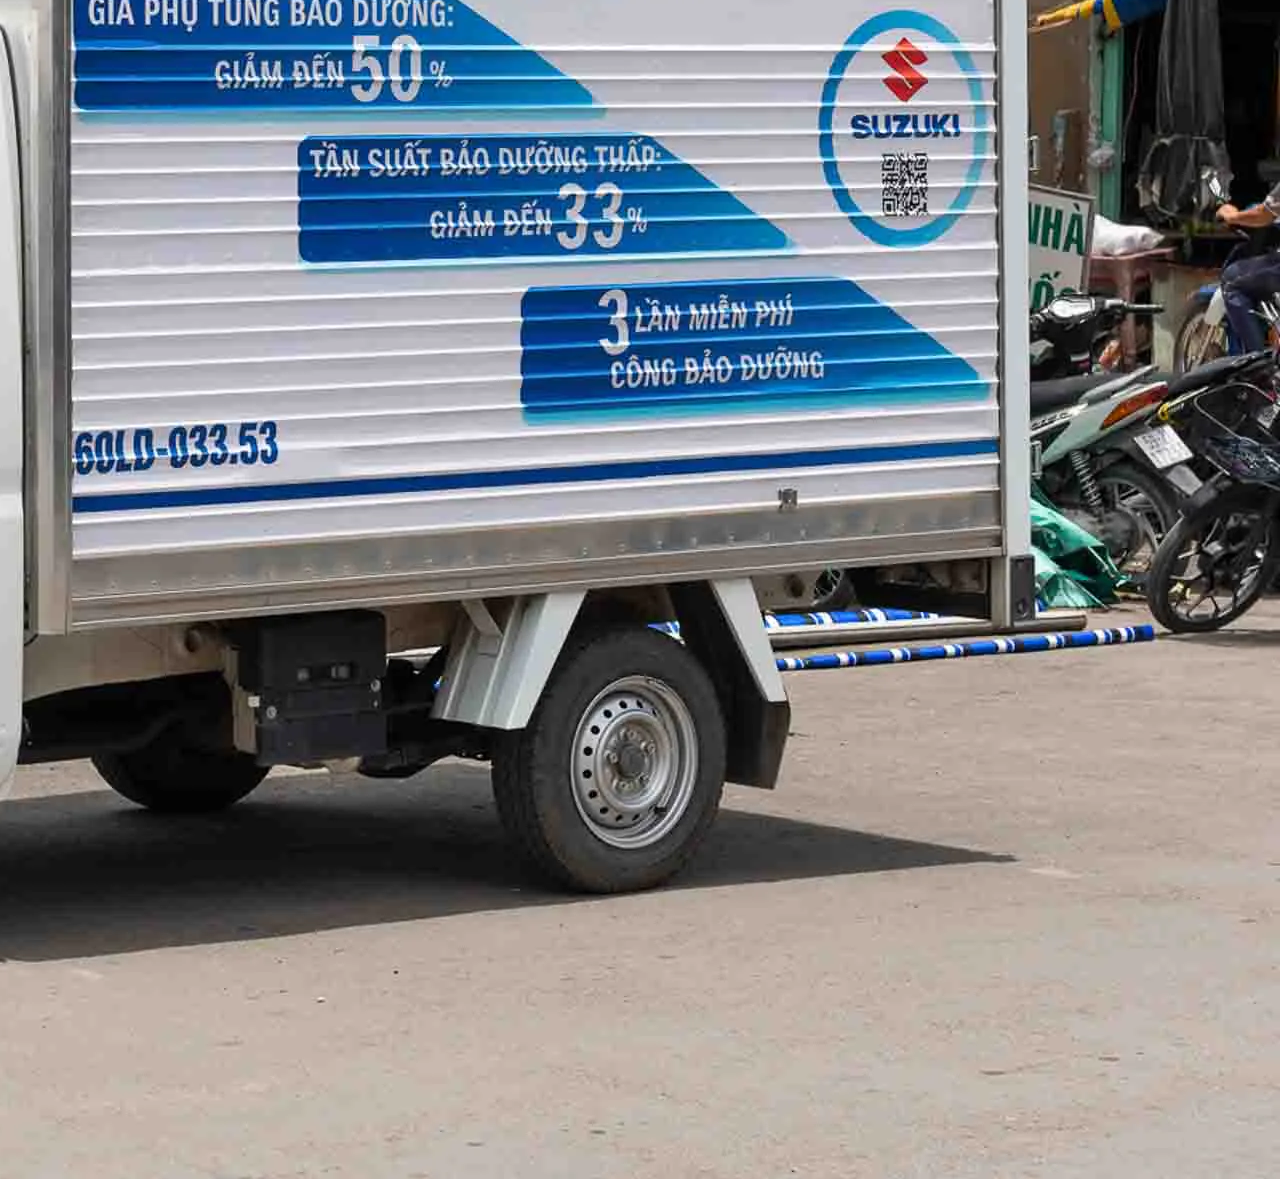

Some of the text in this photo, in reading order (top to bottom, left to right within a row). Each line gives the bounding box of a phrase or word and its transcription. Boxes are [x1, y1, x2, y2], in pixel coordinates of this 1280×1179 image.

[214, 52, 285, 91] GIẢM
[291, 52, 345, 91] ĐẾN
[849, 113, 961, 139] SUZUKI
[310, 135, 662, 178] TẦN SUẤT BẢO DƯỠNG THẤP:
[429, 202, 496, 240] GIẢM
[503, 201, 553, 238] ĐẾN
[598, 289, 794, 356] 3 LẦN MIỄN PHÍ
[610, 345, 825, 389] CÔNG BẢO DƯỠNG
[74, 420, 279, 476] 60LD-033.53
